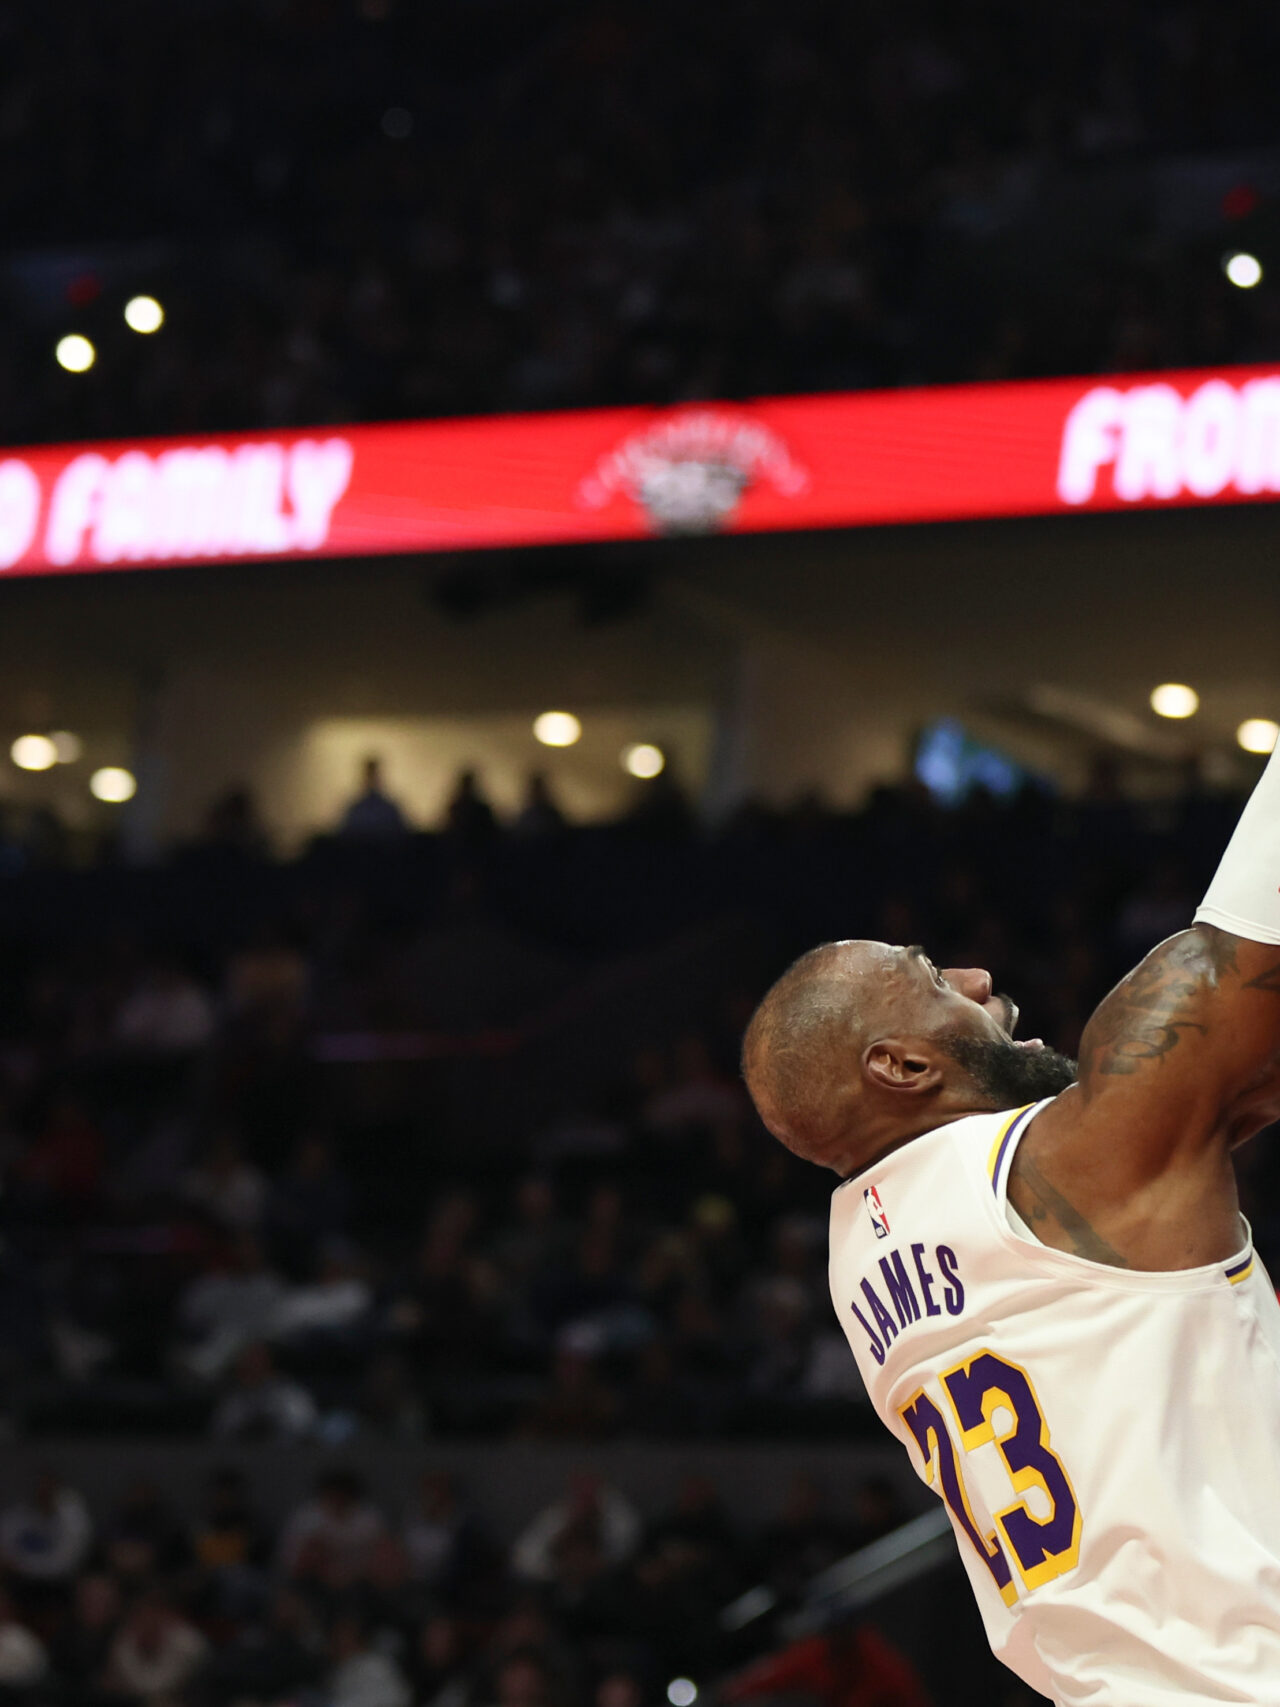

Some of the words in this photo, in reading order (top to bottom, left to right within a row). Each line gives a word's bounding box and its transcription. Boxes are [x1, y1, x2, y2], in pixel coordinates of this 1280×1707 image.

[46, 437, 353, 566] FAMILY
[851, 1243, 965, 1366] JAMES
[896, 1347, 1083, 1609] 23
